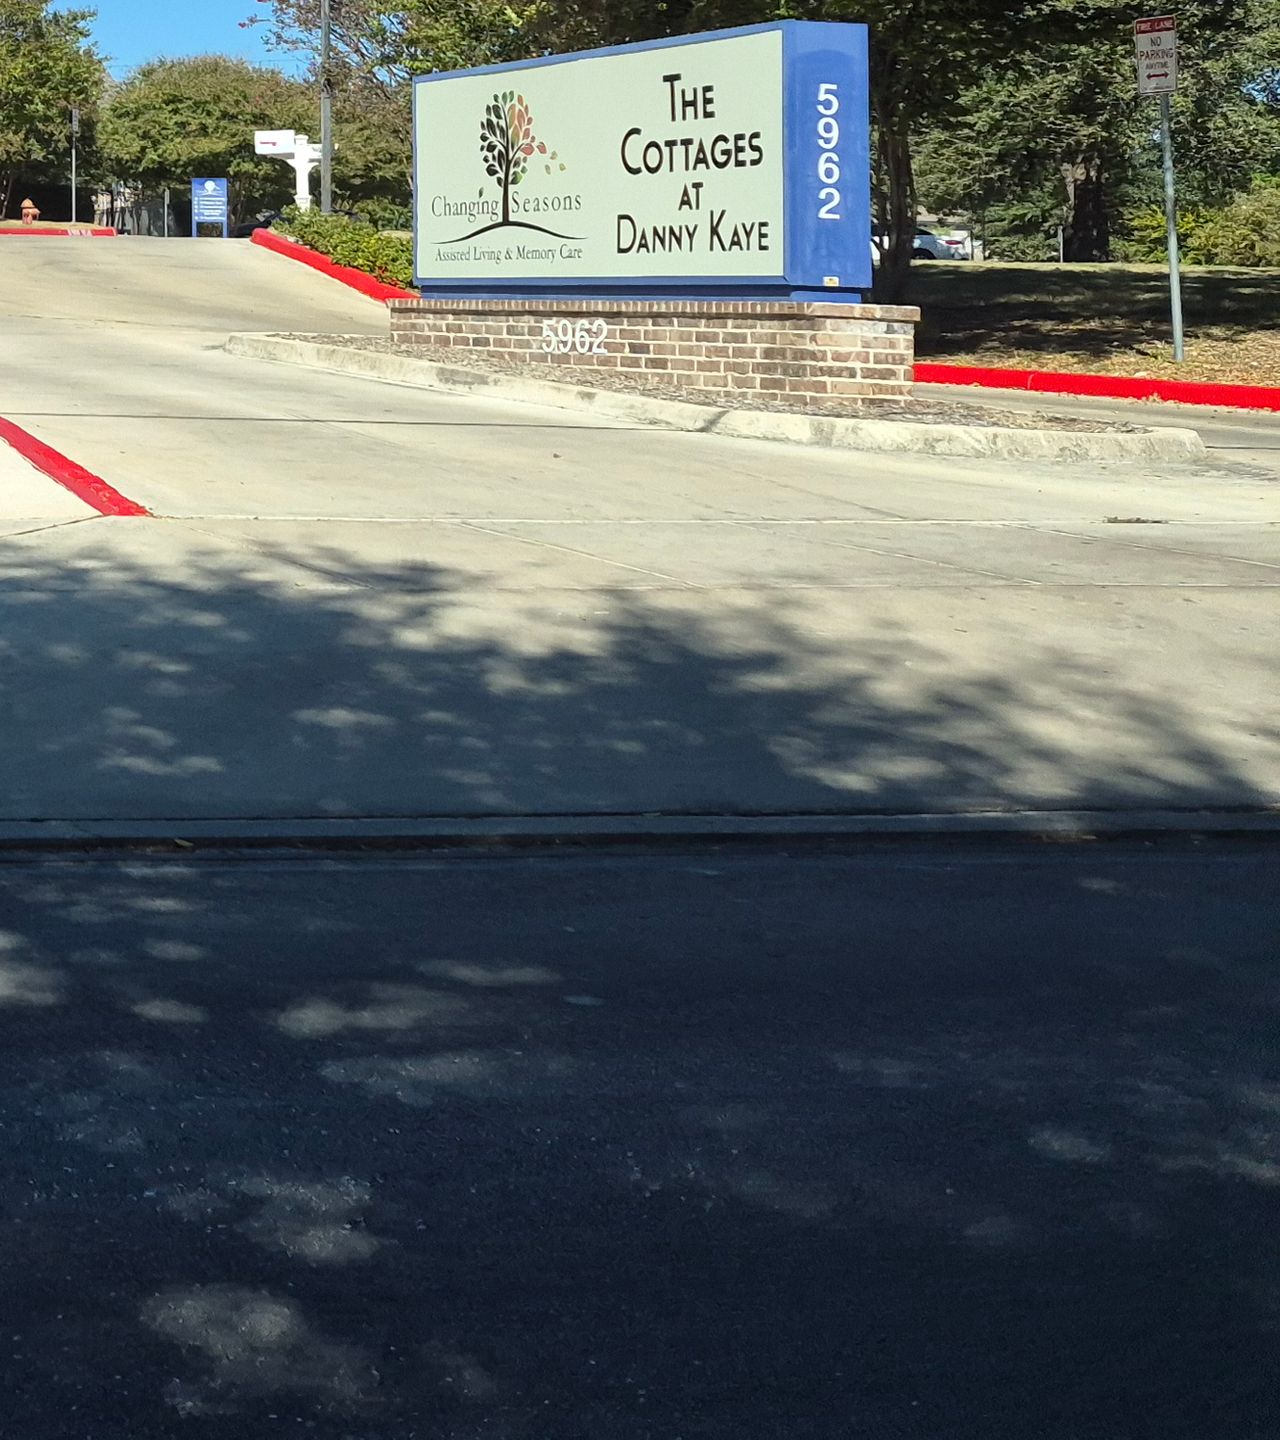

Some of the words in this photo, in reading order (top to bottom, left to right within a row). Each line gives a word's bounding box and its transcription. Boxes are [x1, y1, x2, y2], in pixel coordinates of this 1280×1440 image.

[1140, 47, 1174, 60] PARKING
[1150, 36, 1162, 47] NO
[662, 73, 715, 122] THE
[621, 127, 763, 175] COTTAGES
[816, 83, 840, 220] 5962
[431, 194, 499, 223] Changing
[511, 190, 582, 213] Seasons
[678, 182, 703, 211] AT
[617, 214, 698, 253] DANNY
[709, 209, 769, 252] KAYE
[435, 246, 471, 262] Assisted
[473, 246, 502, 264] Living
[504, 248, 513, 260] &
[516, 245, 556, 264] Memory
[559, 243, 583, 260] Care
[542, 319, 608, 355] 5962
